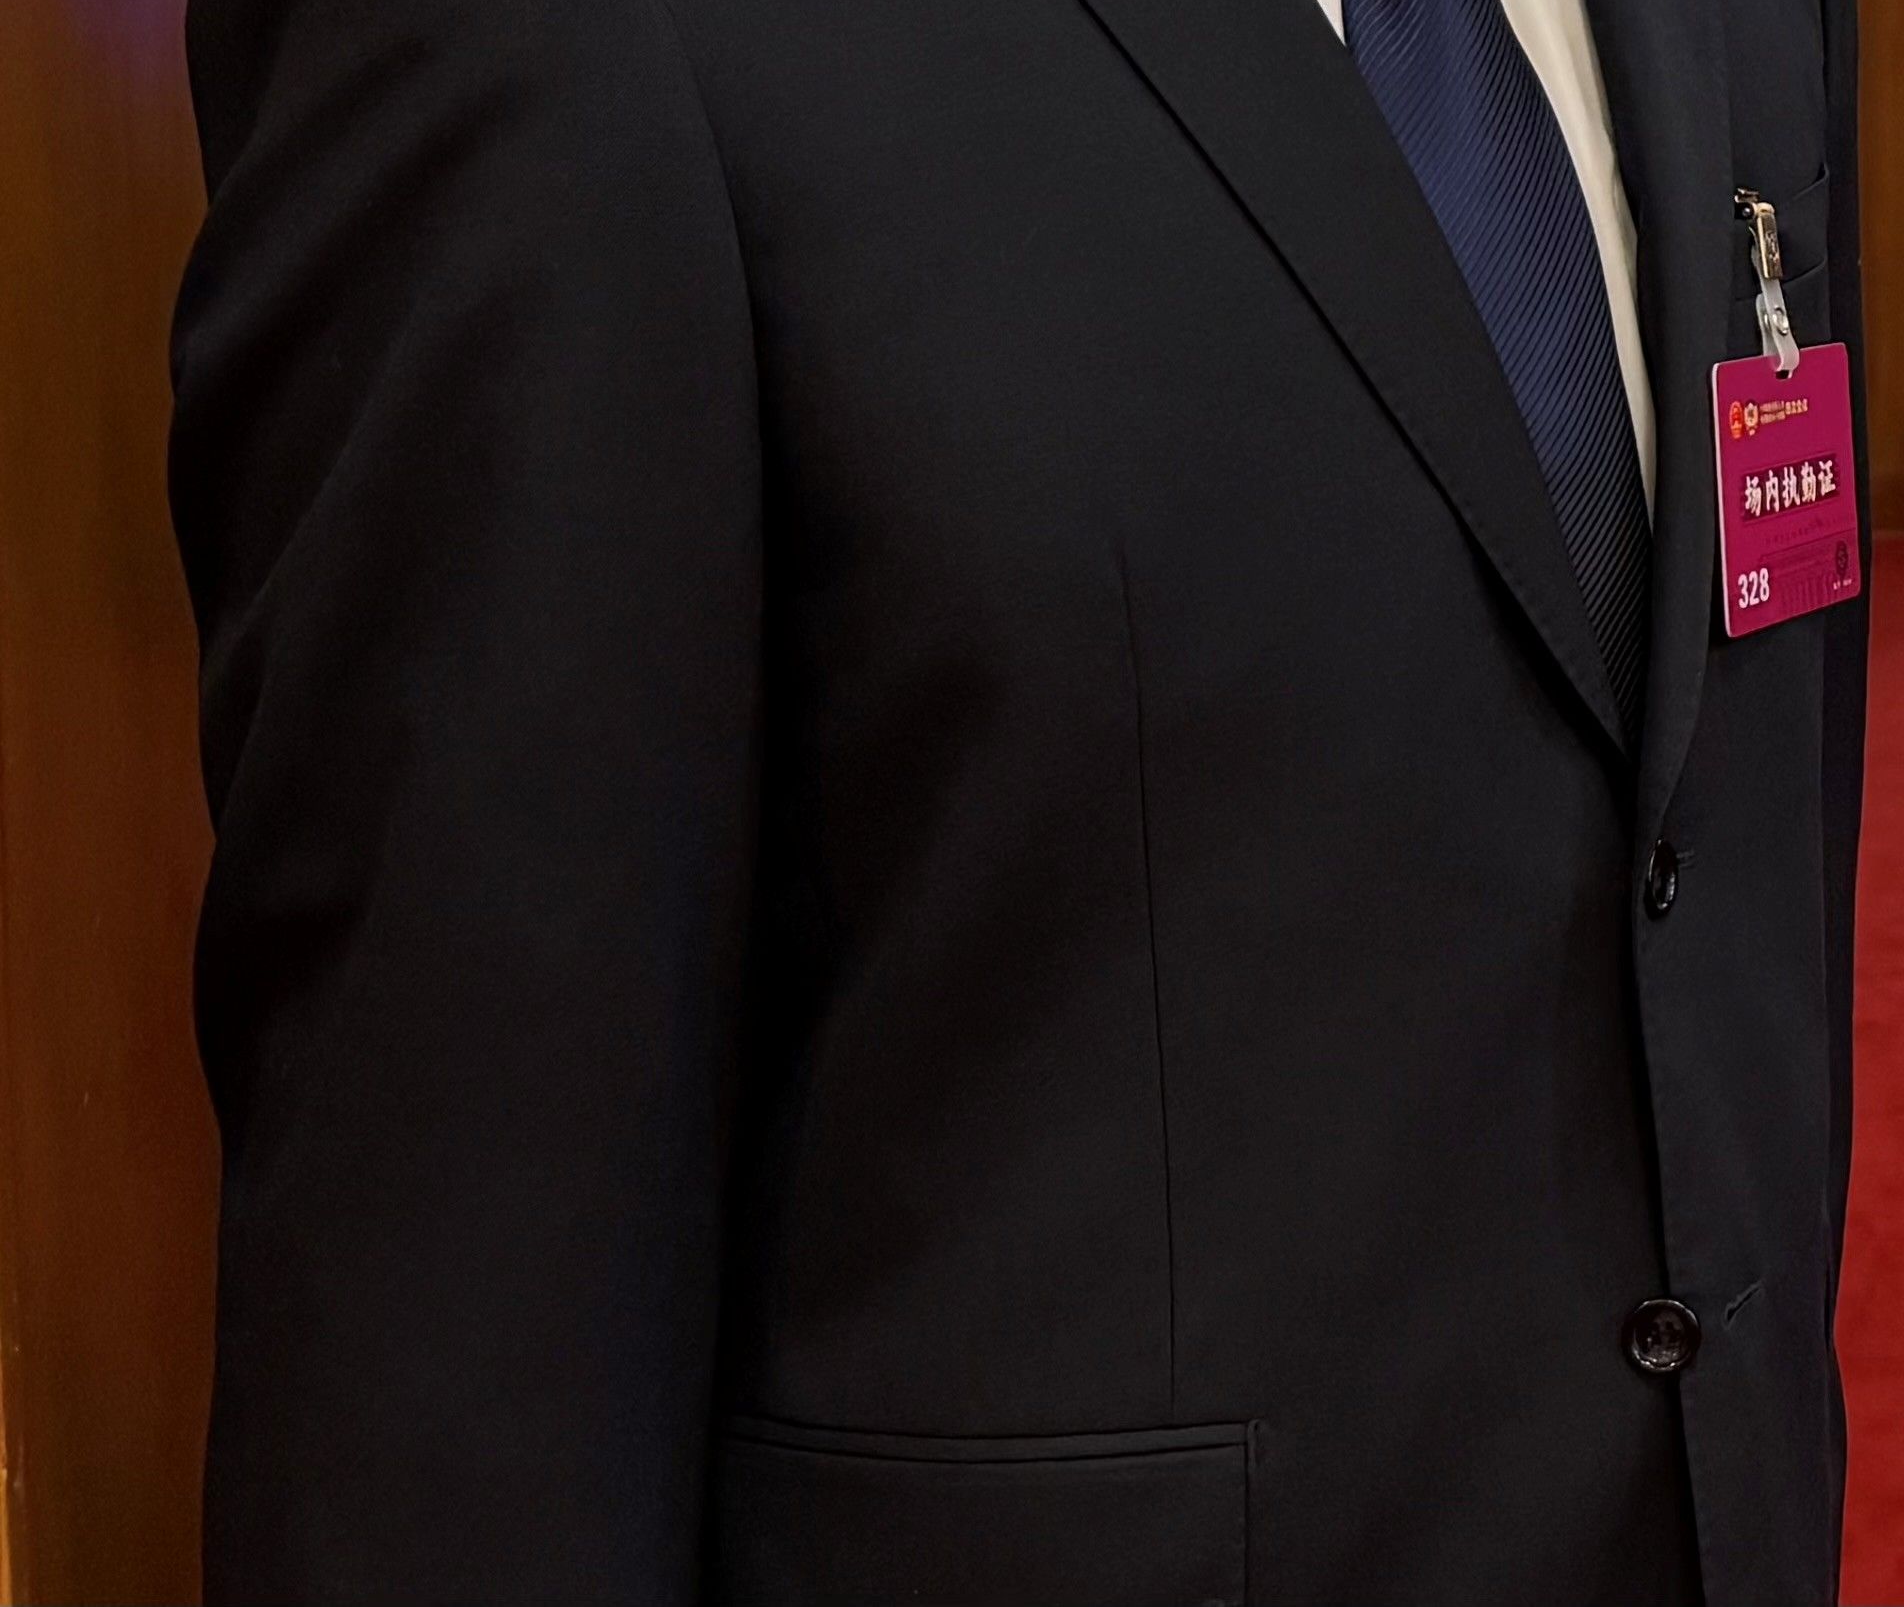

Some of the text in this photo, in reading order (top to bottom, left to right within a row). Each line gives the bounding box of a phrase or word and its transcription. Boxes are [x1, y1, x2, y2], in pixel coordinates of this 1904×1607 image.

[1744, 459, 1836, 516] 场内执勤证
[1738, 568, 1770, 609] 328
